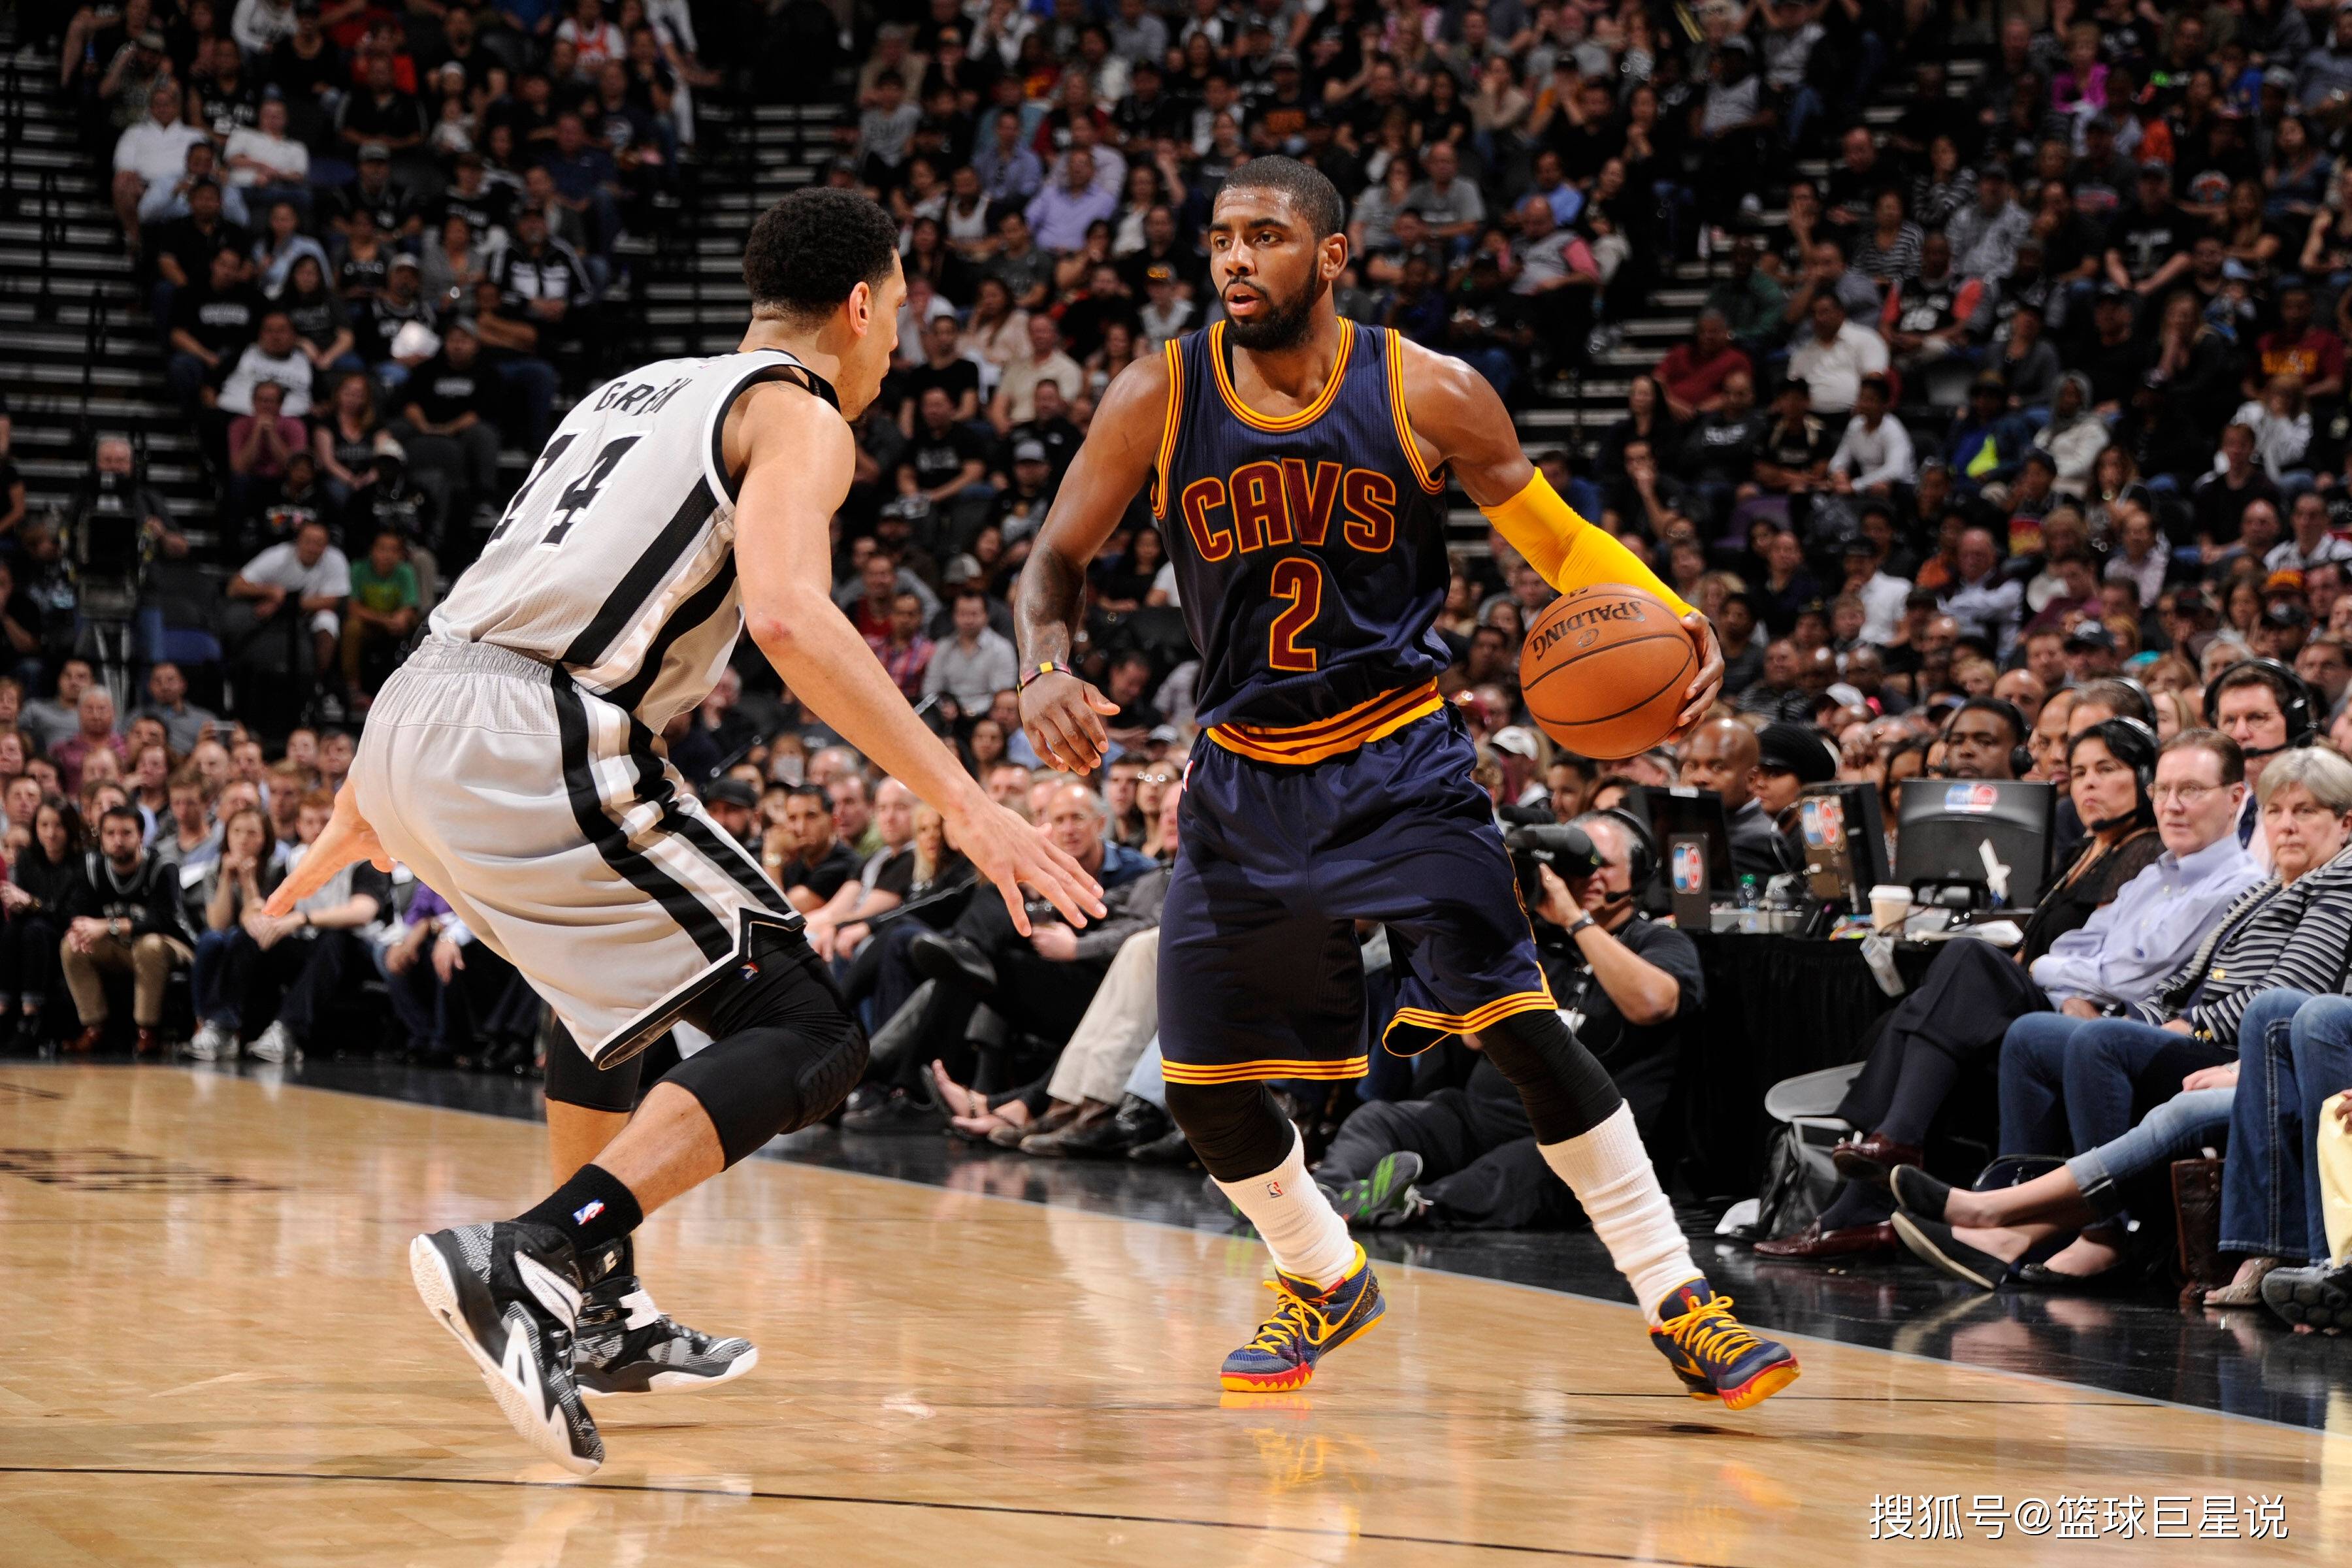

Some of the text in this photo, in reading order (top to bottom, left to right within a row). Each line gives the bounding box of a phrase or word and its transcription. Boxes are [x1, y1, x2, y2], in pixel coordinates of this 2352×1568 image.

[593, 378, 693, 416] GRN
[1181, 457, 1397, 562] CAVS
[1269, 557, 1322, 672] 2
[1531, 600, 1646, 661] SPALDING
